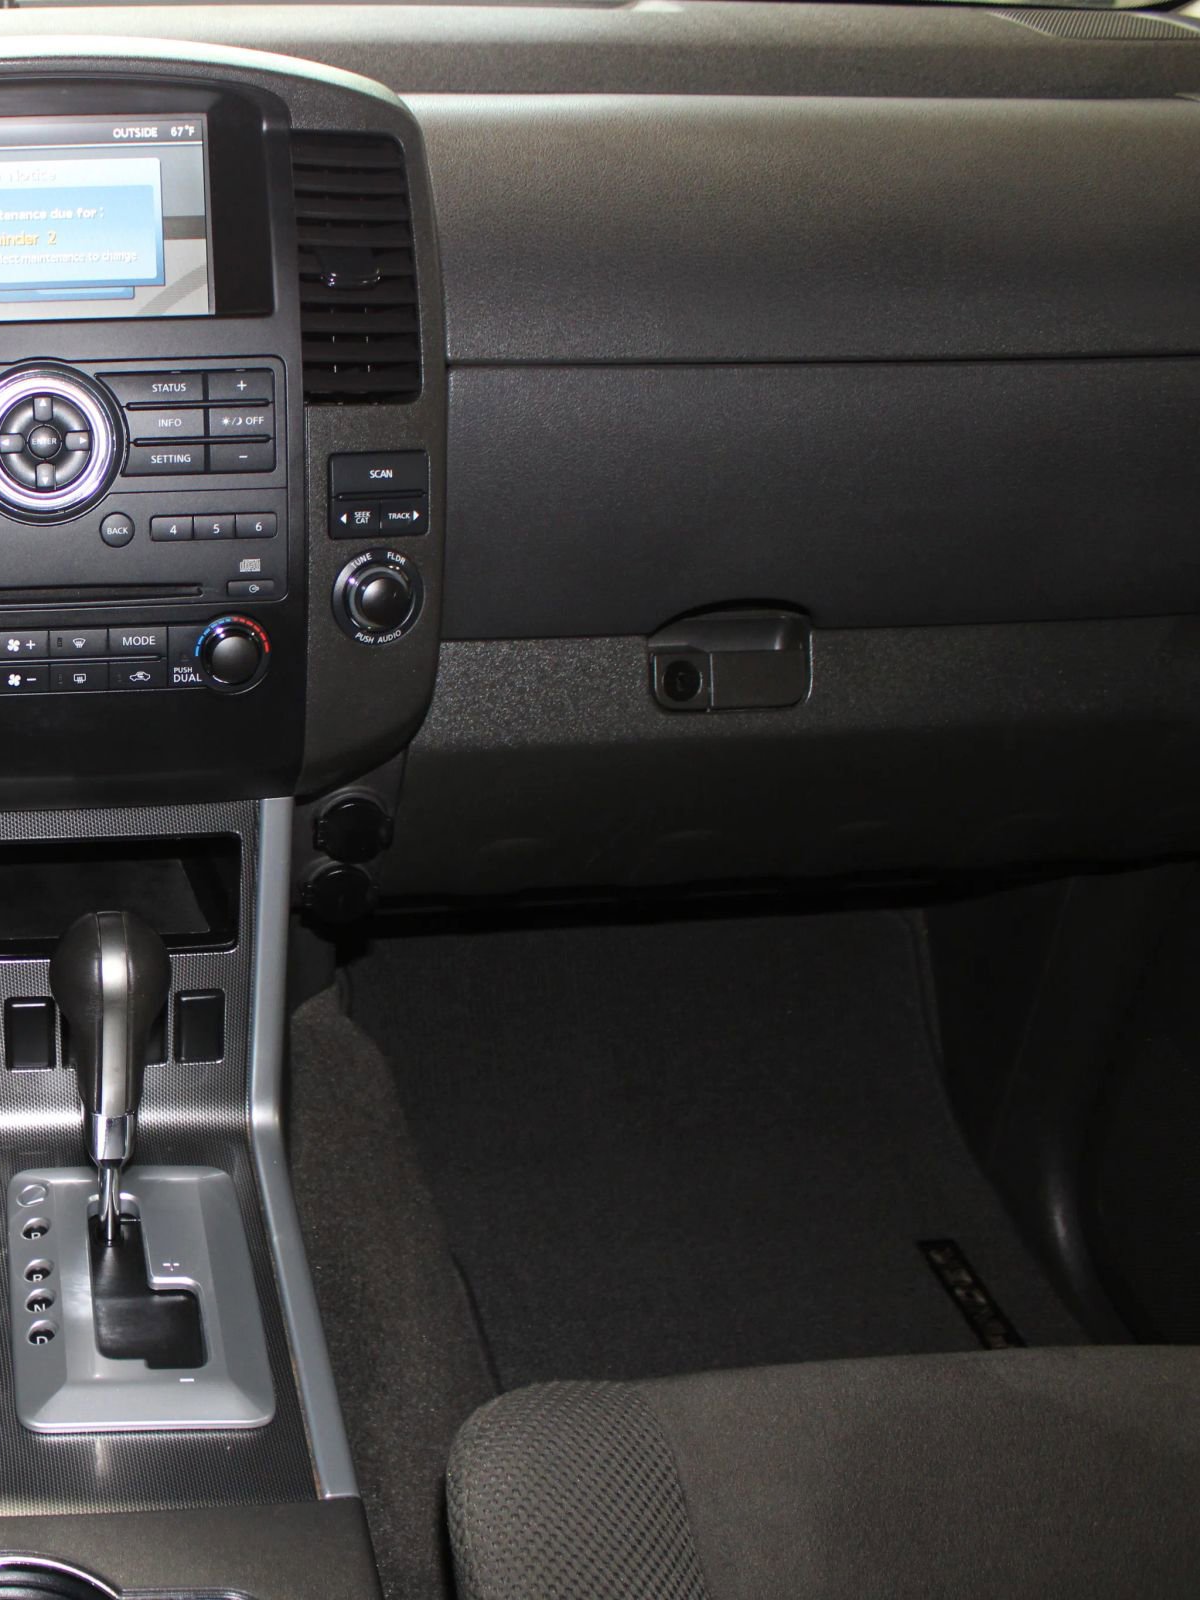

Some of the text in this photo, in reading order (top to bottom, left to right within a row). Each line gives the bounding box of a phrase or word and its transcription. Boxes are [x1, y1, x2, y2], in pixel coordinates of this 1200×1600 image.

[113, 127, 158, 139] OUTSIDE
[50, 207, 73, 219] due
[47, 231, 57, 245] 2
[152, 383, 186, 393] STATUS
[158, 418, 182, 427] INFO
[245, 416, 265, 425] OFF
[31, 437, 57, 445] ENTER
[150, 454, 191, 464] SETTING
[369, 469, 393, 479] SCAN
[388, 512, 410, 520] TRACK
[106, 526, 128, 535] BACK
[170, 525, 177, 534] 4
[213, 524, 220, 534] 5
[255, 522, 262, 531] 6
[350, 551, 407, 569] TUNE FLDR
[122, 635, 156, 646] MODE
[355, 629, 402, 644] PUSH AUDIO
[173, 666, 193, 674] PUSH
[173, 673, 202, 683] DUAL
